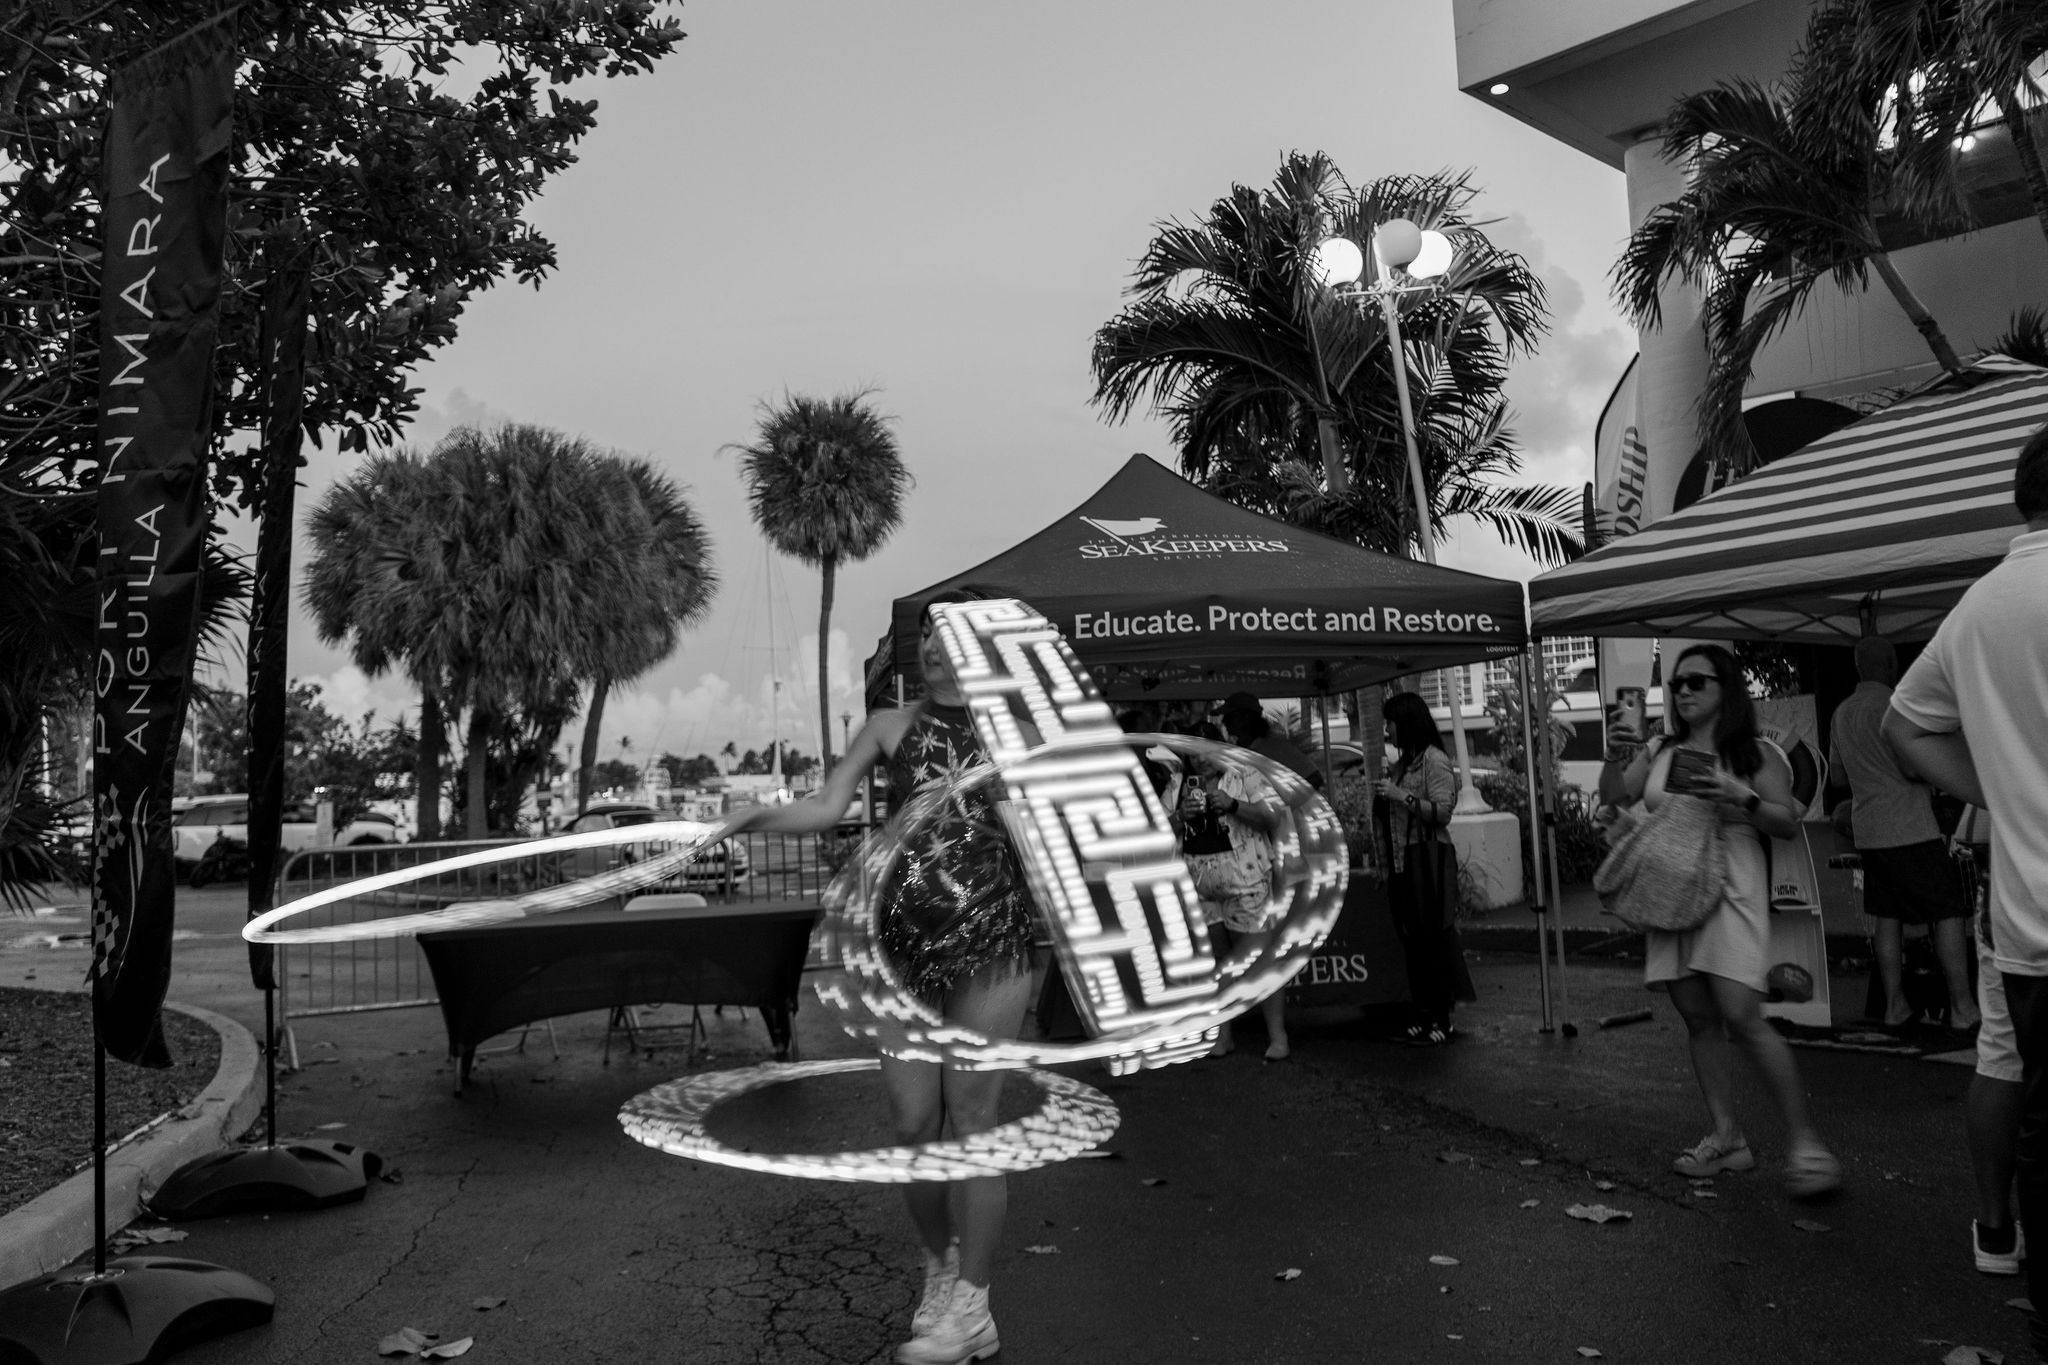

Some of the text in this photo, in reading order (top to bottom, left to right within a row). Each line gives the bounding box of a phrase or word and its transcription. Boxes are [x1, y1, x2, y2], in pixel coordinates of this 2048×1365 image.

[96, 152, 171, 754] PORT NIMARA
[1078, 539, 1290, 559] SEAKEEPERS
[1130, 533, 1262, 542] INTERNATIONAL
[124, 503, 166, 755] ANGUILLA
[1074, 610, 1202, 639] Educate.
[1208, 605, 1318, 632] Protect
[1324, 607, 1376, 632] and
[1383, 607, 1501, 632] Restore.
[1486, 645, 1519, 653] LOGOTENT
